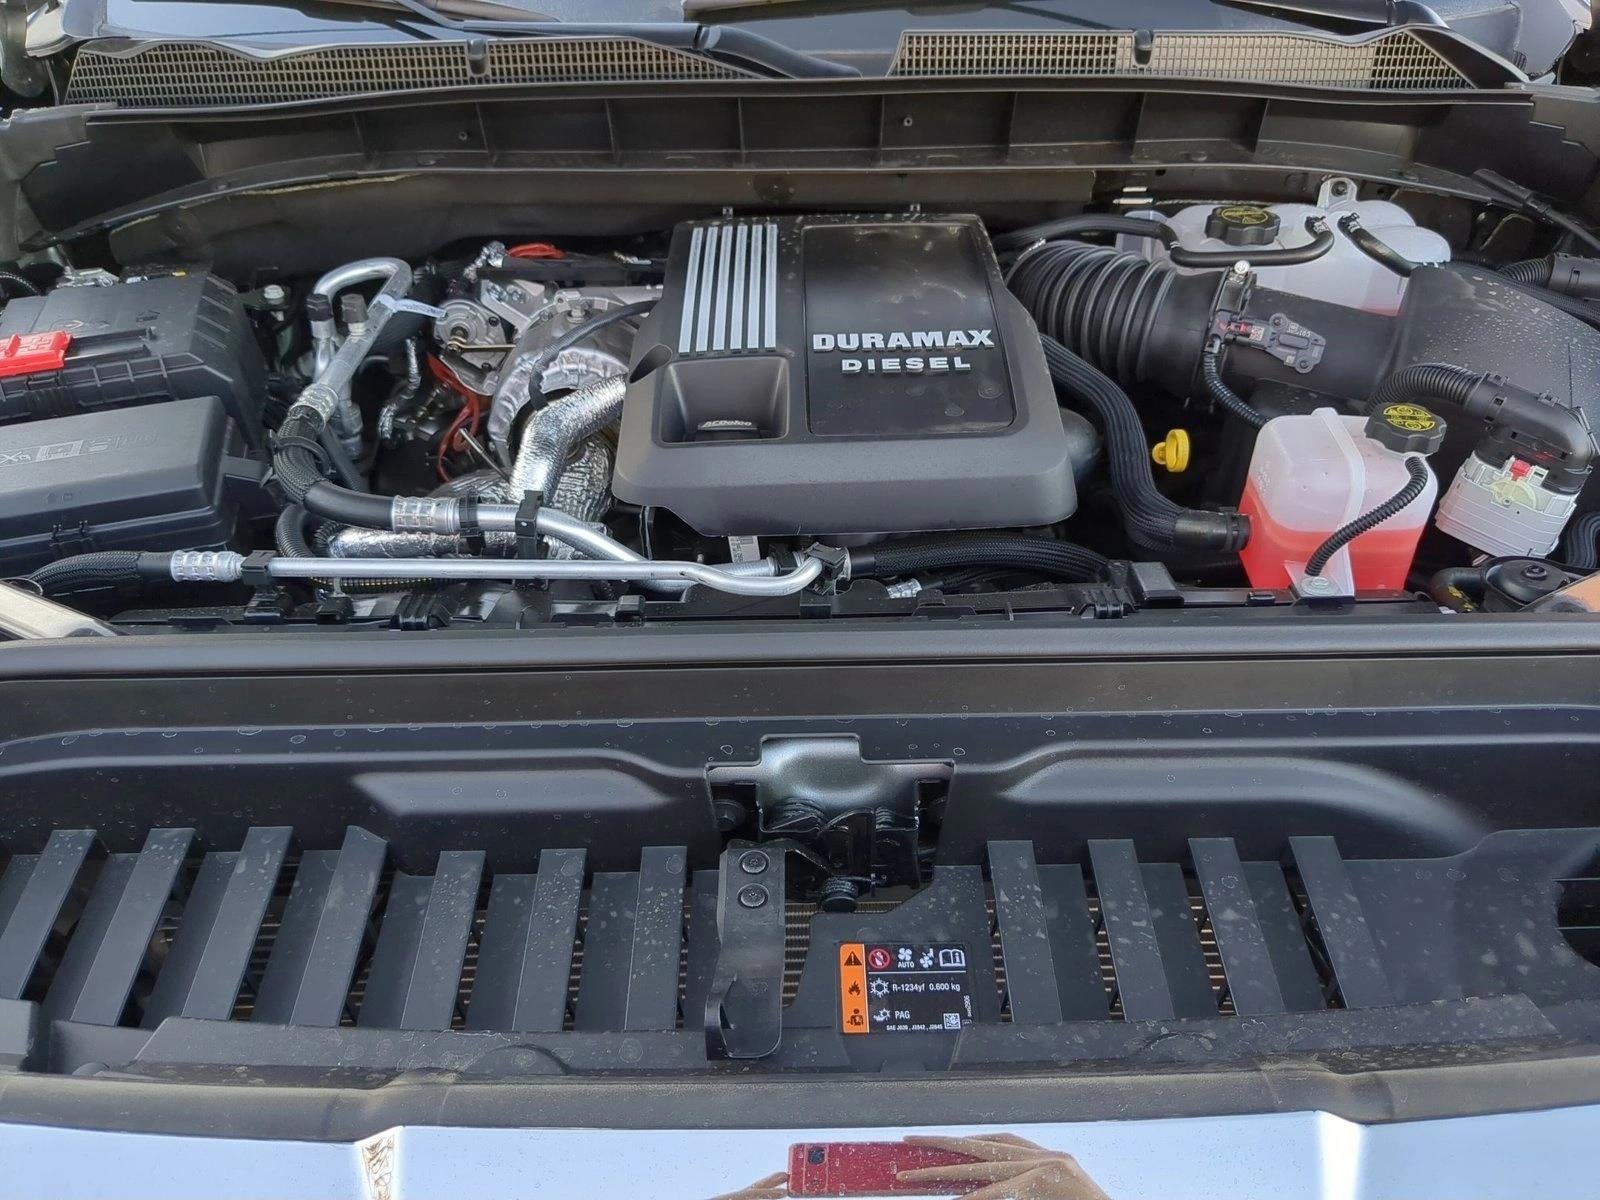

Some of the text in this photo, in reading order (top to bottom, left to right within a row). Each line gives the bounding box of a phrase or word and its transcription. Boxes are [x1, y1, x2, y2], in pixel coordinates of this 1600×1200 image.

[813, 330, 995, 352] DURAMAX
[842, 357, 970, 374] DIESEL
[892, 983, 960, 992] R-1234yf 0.600 kg
[895, 1011, 910, 1019] PAG
